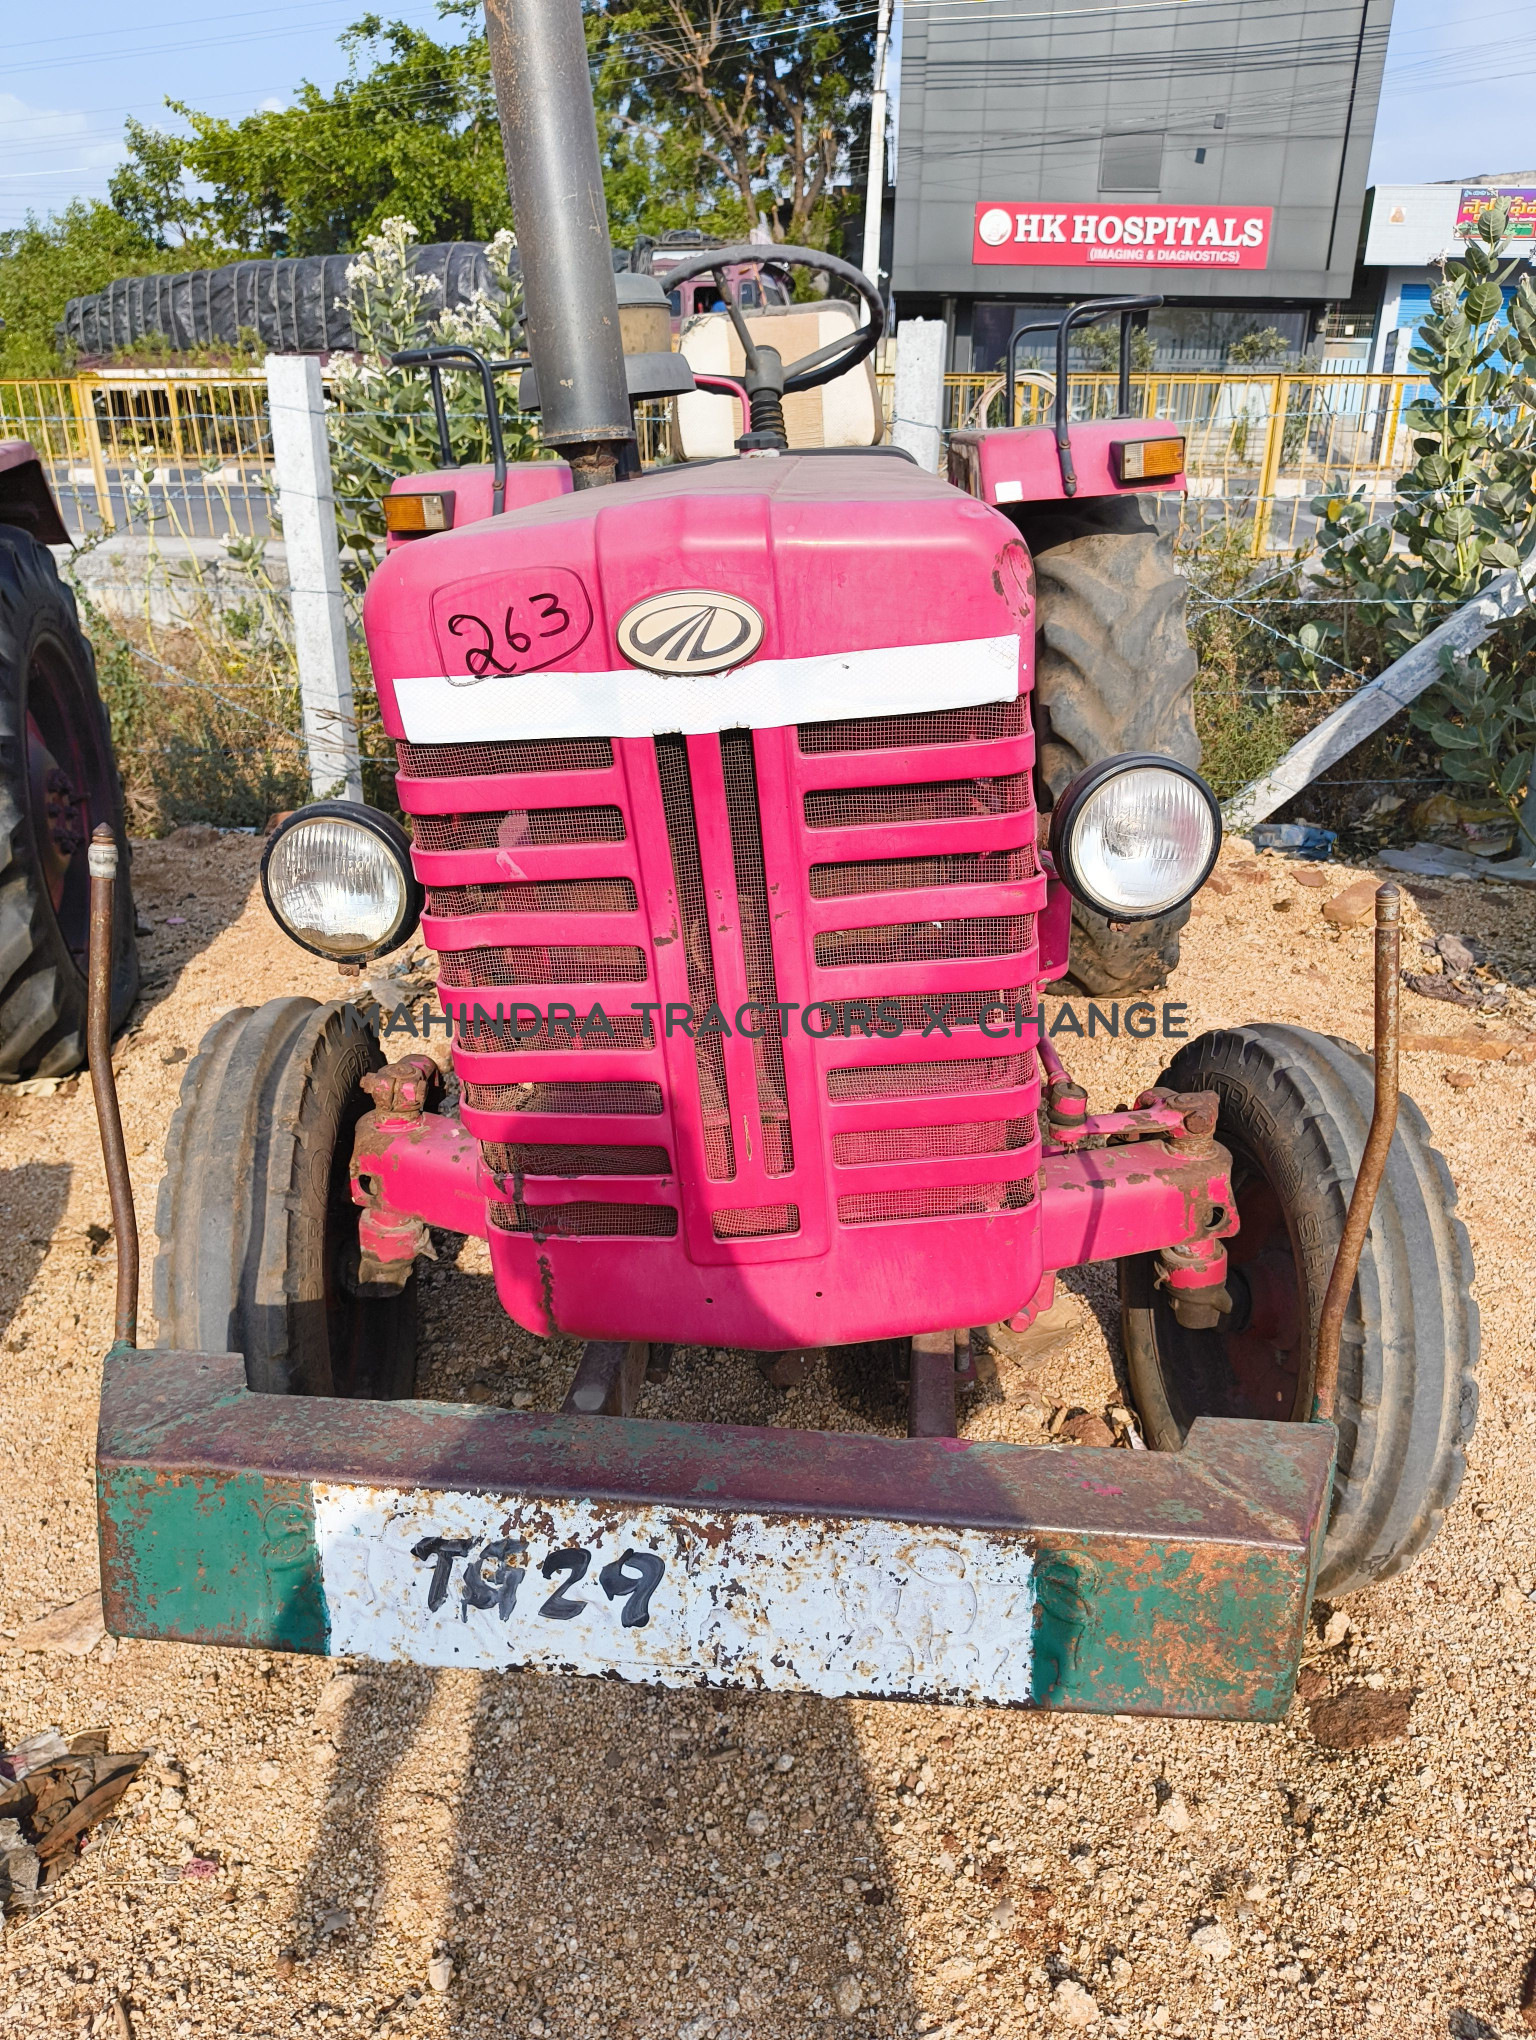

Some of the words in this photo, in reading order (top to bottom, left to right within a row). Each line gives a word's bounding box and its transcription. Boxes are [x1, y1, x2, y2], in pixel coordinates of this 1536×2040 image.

[1014, 214, 1066, 243] HK
[1071, 215, 1264, 248] HOSPITALS
[1089, 248, 1143, 261] (IMAGING
[1146, 249, 1155, 261] &
[1157, 250, 1240, 263] DIAGNOSTICS)
[447, 592, 570, 675] 263
